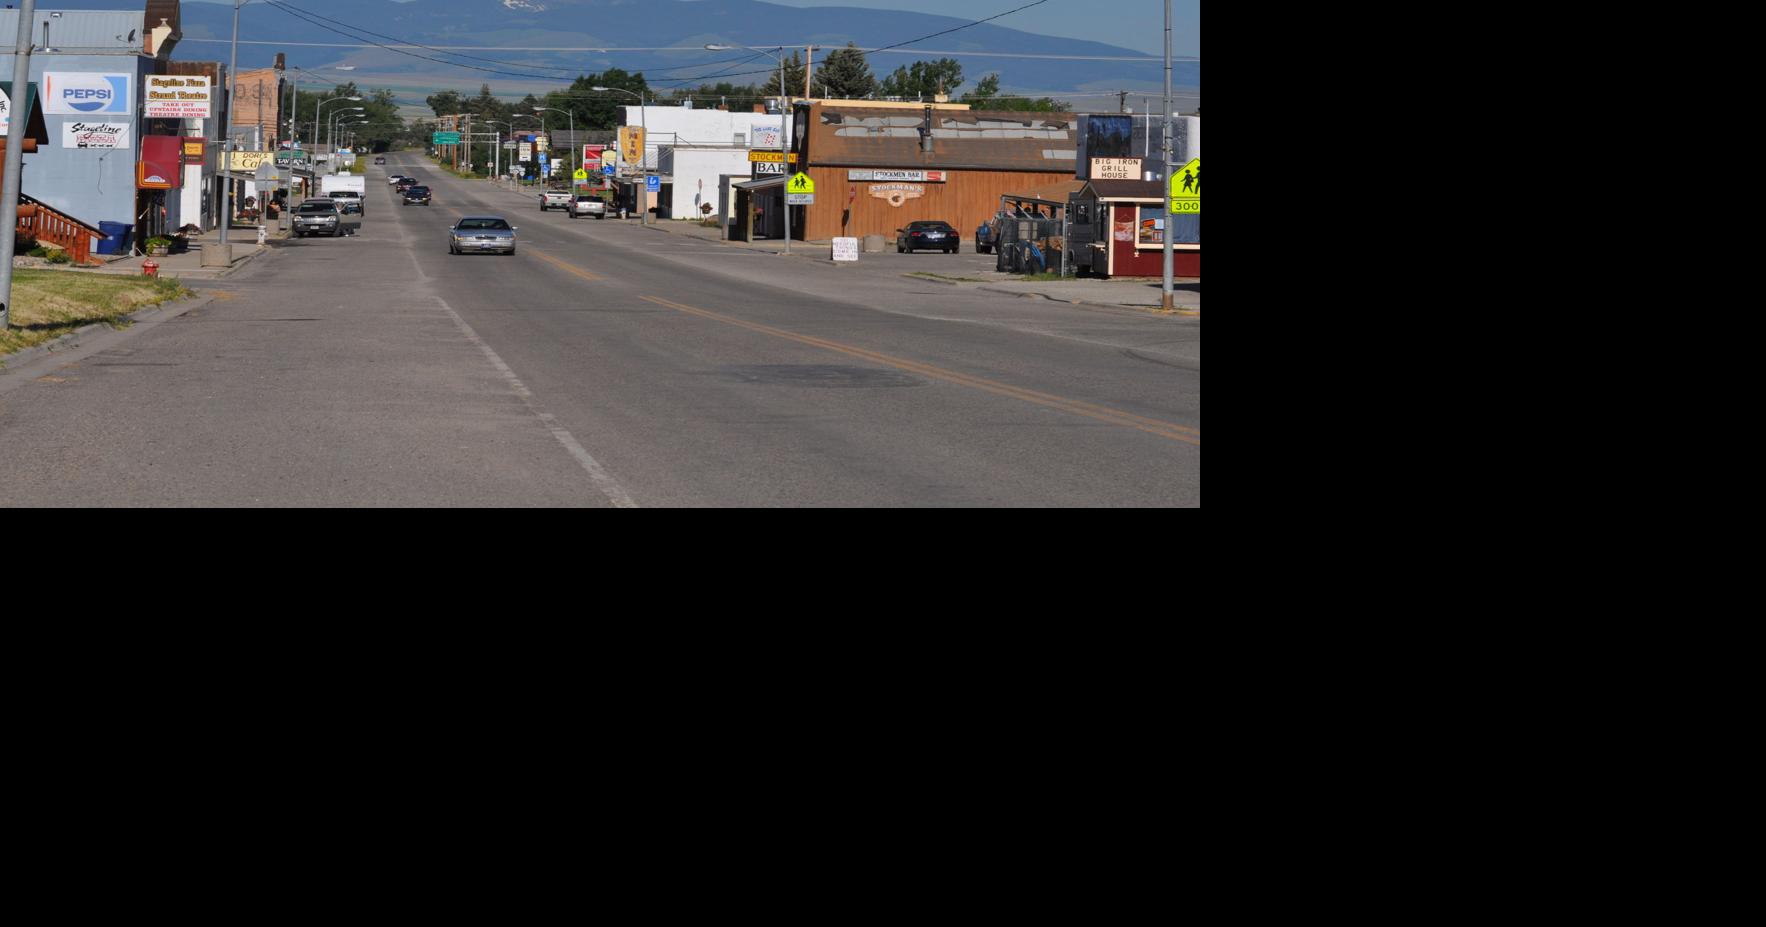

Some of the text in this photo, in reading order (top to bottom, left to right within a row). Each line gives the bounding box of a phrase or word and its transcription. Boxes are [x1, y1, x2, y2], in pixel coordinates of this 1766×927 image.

[63, 88, 111, 99] PEPSI
[71, 122, 122, 138] Stageline
[750, 153, 795, 161] STOCKMN
[242, 159, 262, 168] Caf
[277, 158, 304, 166] TAVRN
